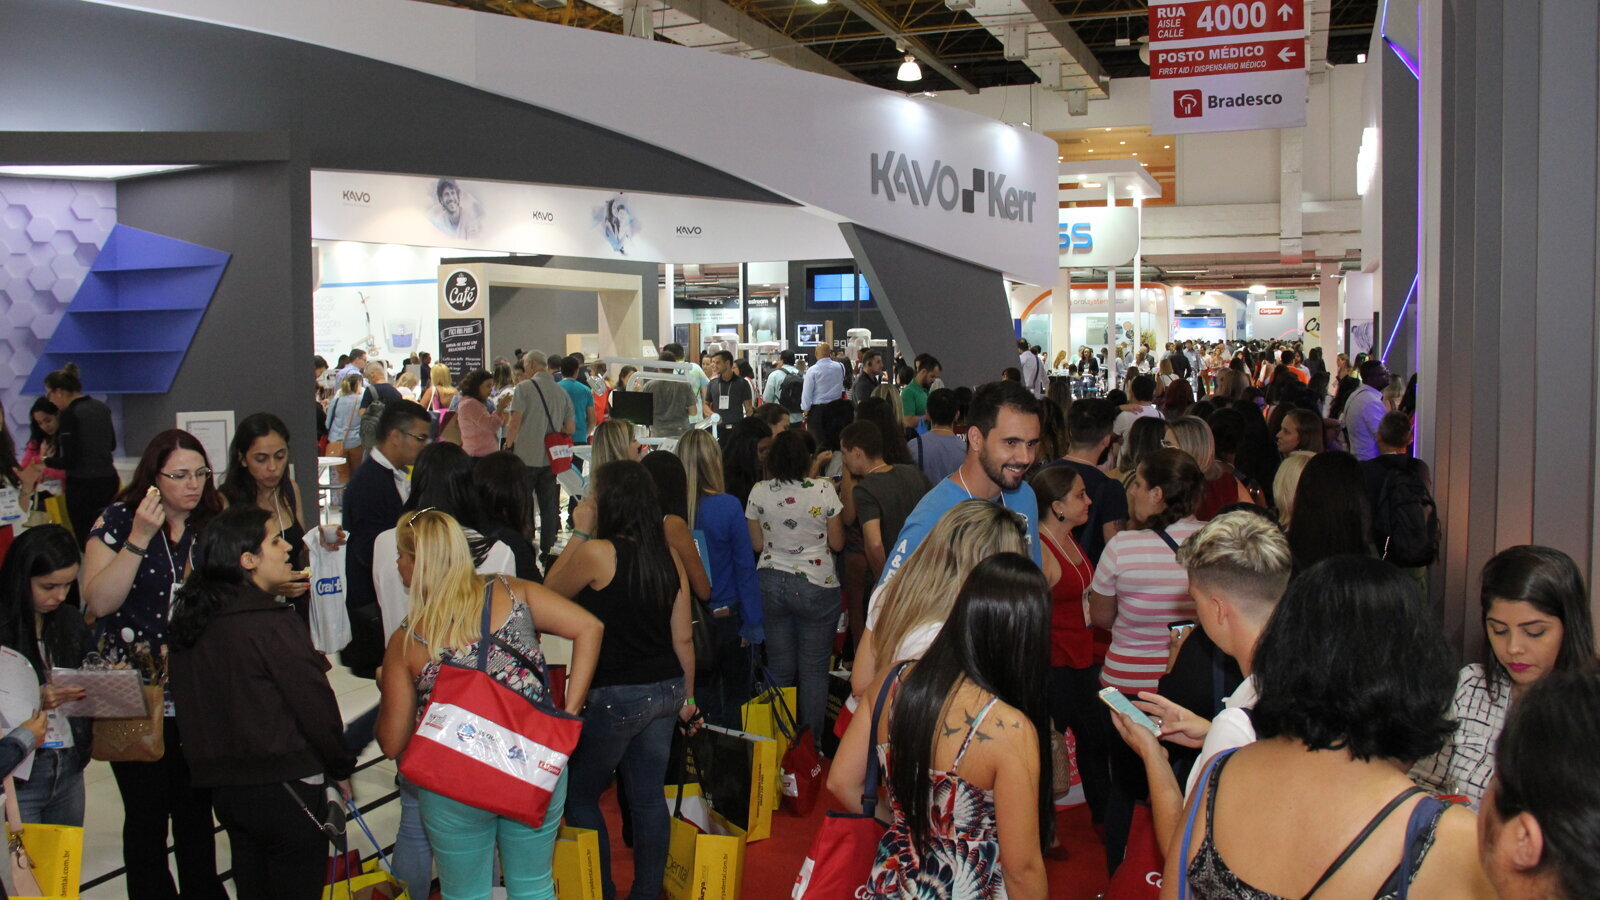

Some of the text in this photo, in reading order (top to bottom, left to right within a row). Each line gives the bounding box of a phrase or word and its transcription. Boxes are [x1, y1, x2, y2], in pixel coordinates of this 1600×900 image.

[1157, 7, 1186, 18] RUA
[1197, 1, 1267, 32] 4000
[1157, 19, 1181, 28] AISLE
[1157, 29, 1184, 39] CALLE
[1158, 45, 1264, 64] POSTO MÉDICO
[1158, 66, 1178, 75] FIRST
[1178, 65, 1190, 74] AID
[1194, 62, 1239, 73] DISPENSARIO
[1240, 59, 1267, 69] MÉDICO
[1208, 93, 1283, 109] Bradesco
[871, 150, 1037, 223] KAVO Kerr
[343, 189, 371, 203] KAVO
[533, 210, 554, 222] KAVO
[676, 225, 702, 235] KAVO
[449, 286, 475, 307] Café
